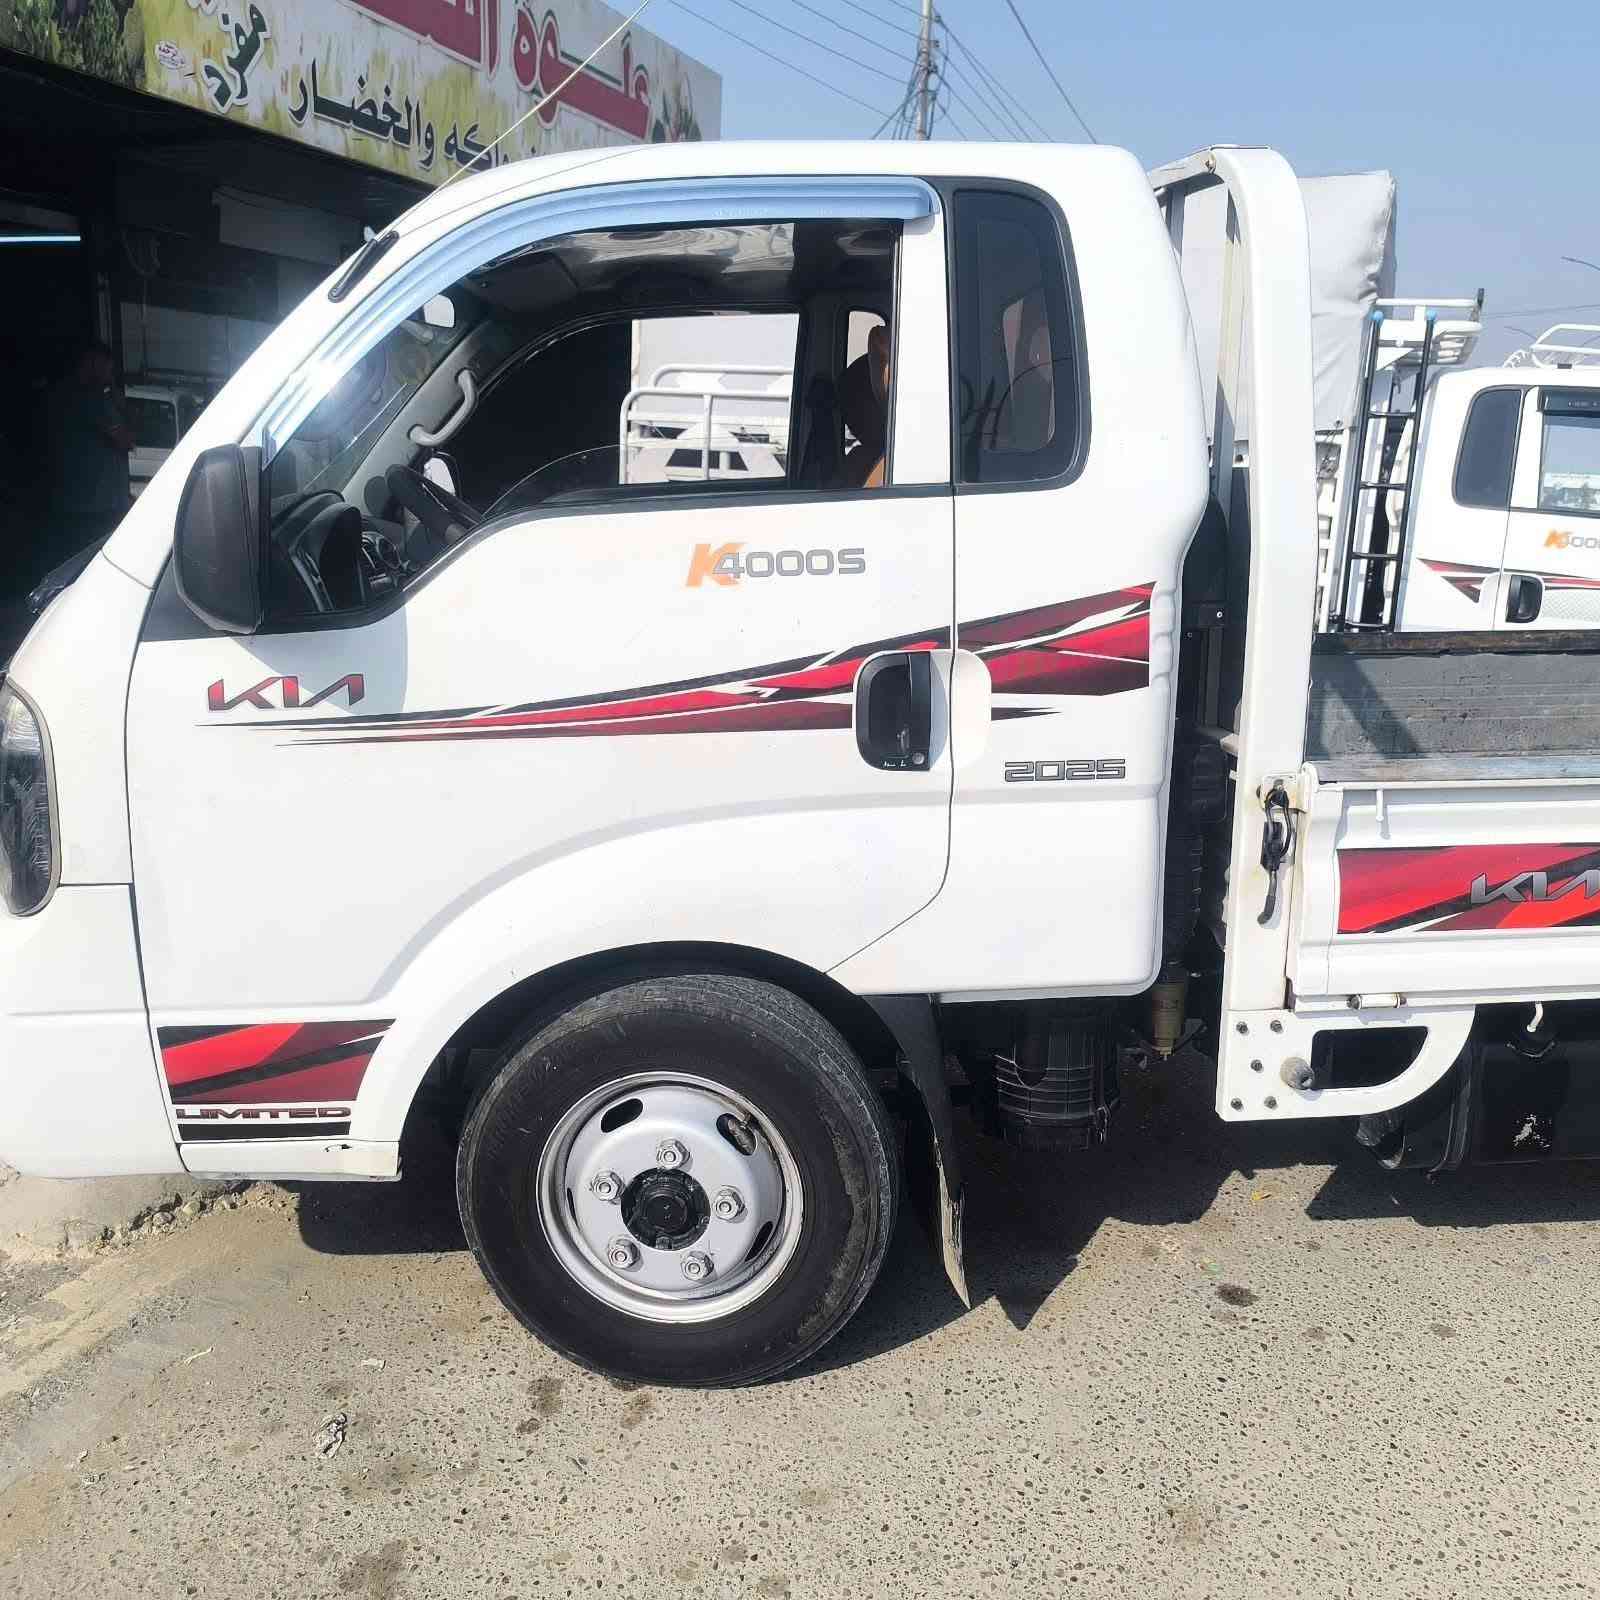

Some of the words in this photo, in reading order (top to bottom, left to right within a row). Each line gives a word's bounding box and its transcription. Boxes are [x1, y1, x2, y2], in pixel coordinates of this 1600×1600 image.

[203, 3, 268, 109] مفرد
[287, 57, 434, 169] والخضار
[686, 542, 866, 587] K4000S
[207, 673, 366, 711] KIA
[1005, 758, 1126, 782] 2025
[1470, 868, 1600, 904] KIA
[176, 1106, 351, 1120] LIMITED
